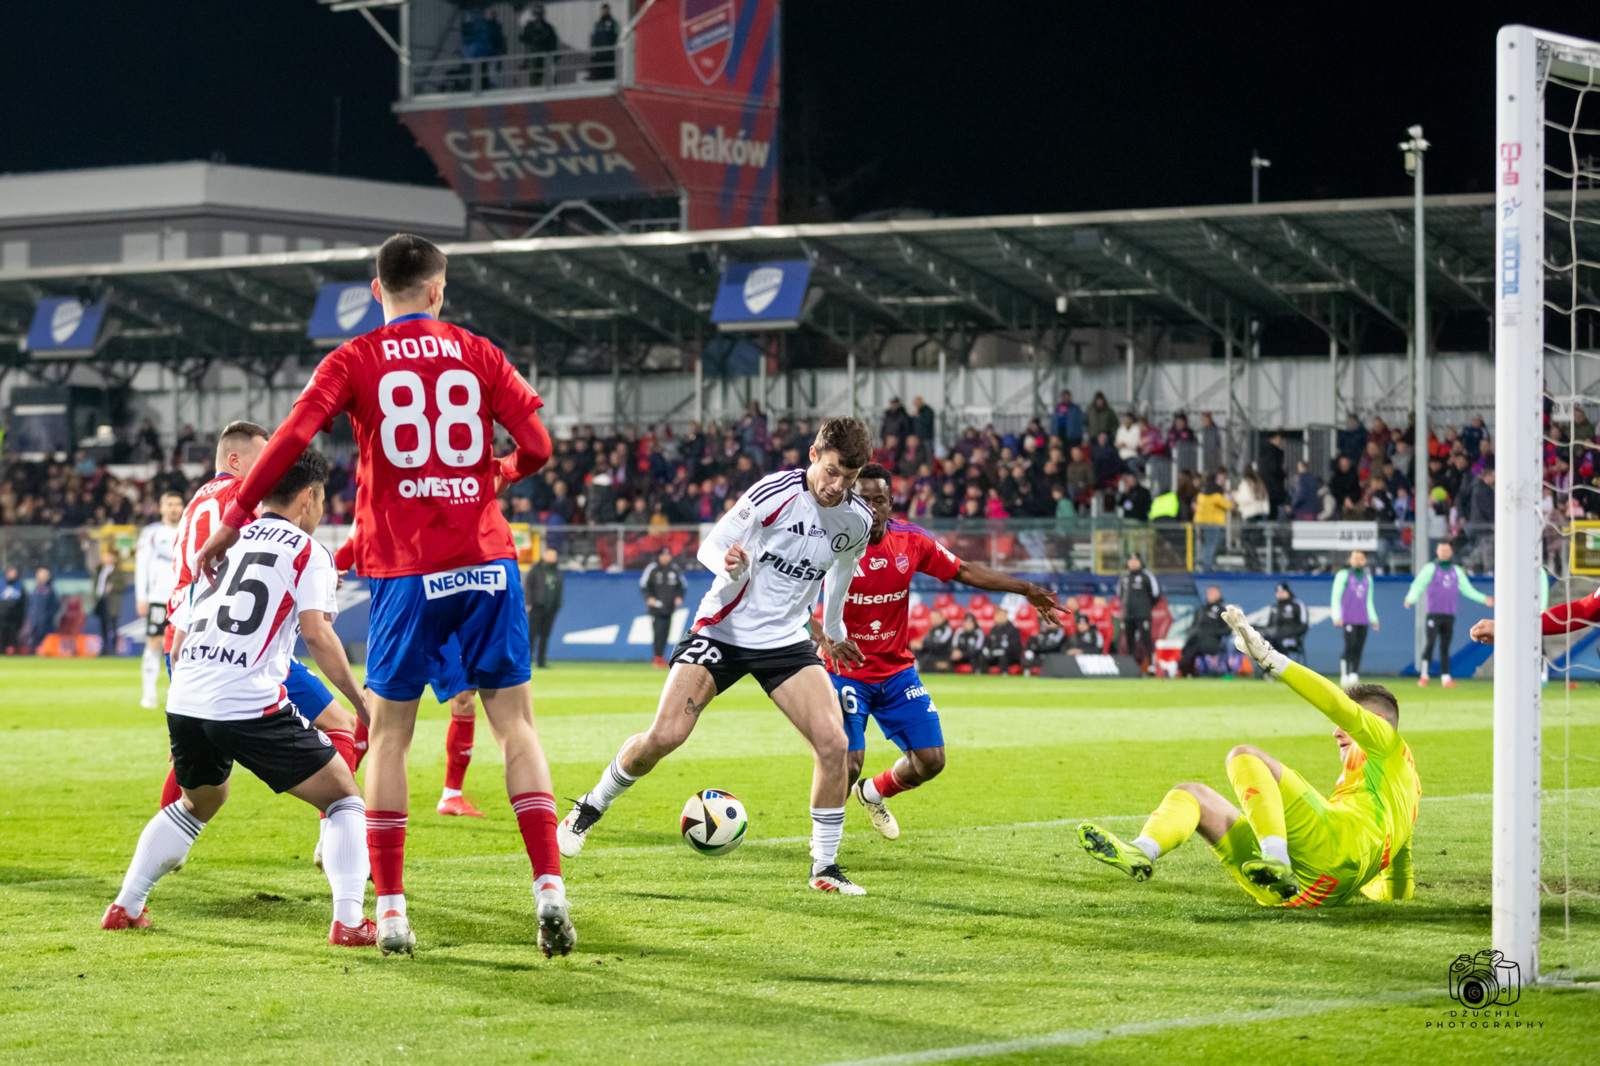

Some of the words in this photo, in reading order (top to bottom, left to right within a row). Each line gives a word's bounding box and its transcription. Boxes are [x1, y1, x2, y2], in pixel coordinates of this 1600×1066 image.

[680, 122, 769, 168] Raków
[378, 369, 484, 468] 88
[188, 552, 278, 636] 25
[429, 571, 501, 593] NEONET
[846, 589, 908, 605] Hisense
[680, 639, 722, 664] 28
